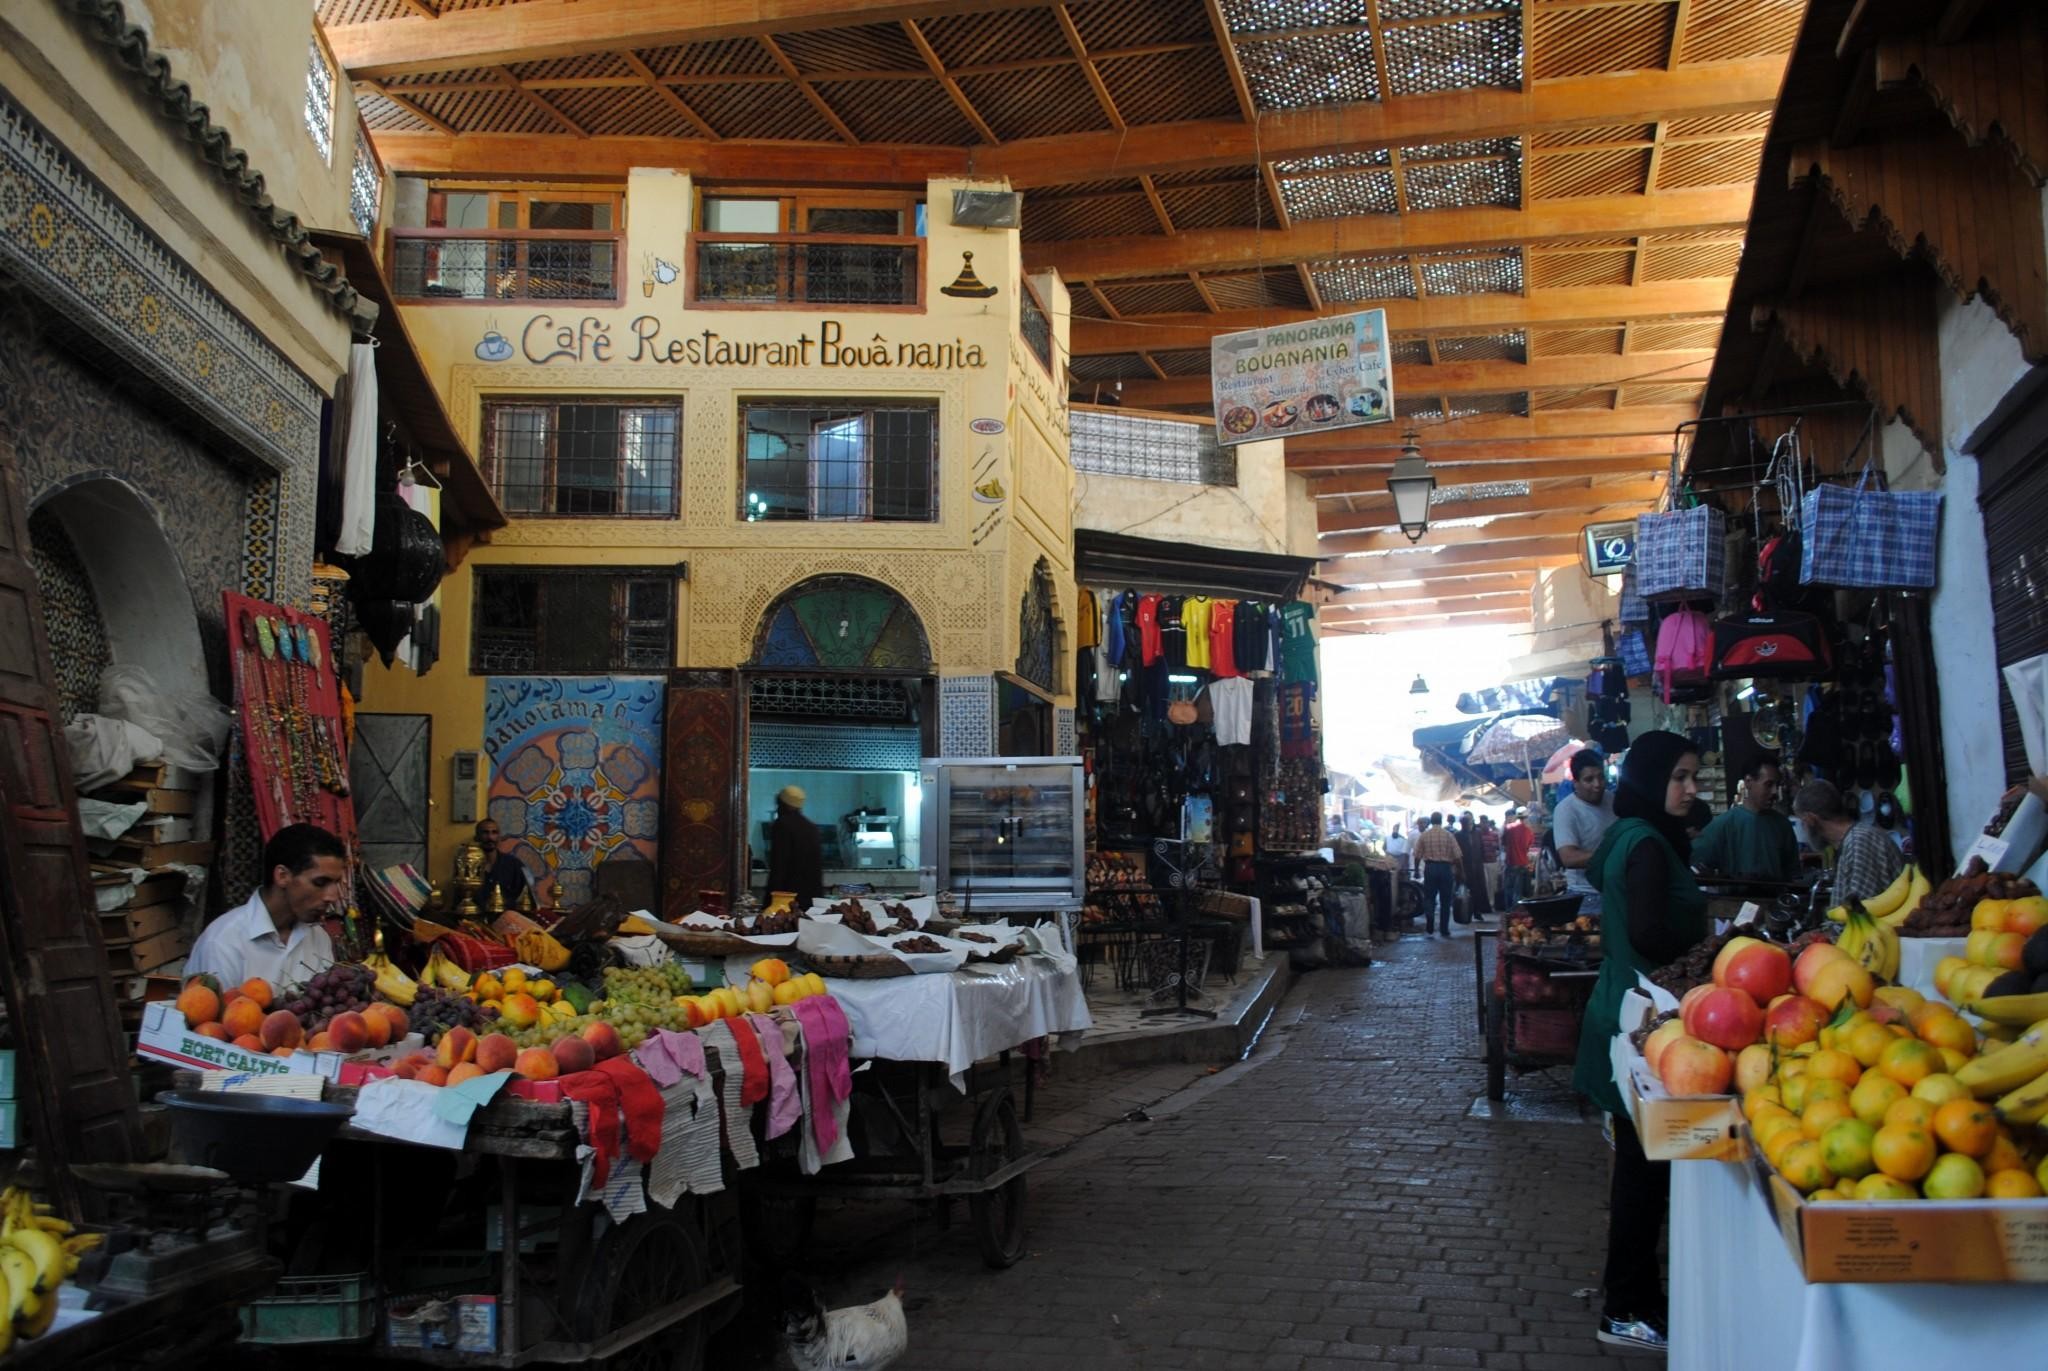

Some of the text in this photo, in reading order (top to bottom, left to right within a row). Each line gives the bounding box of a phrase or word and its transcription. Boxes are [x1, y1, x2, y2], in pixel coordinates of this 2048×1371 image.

[521, 314, 613, 364] Café
[628, 315, 815, 367] Restaurant
[1266, 321, 1356, 347] PANORAMA
[1236, 342, 1349, 375] BOUANANIA
[1218, 374, 1274, 392] Restaurant
[484, 701, 604, 768] panorama
[180, 1037, 226, 1063] HORT
